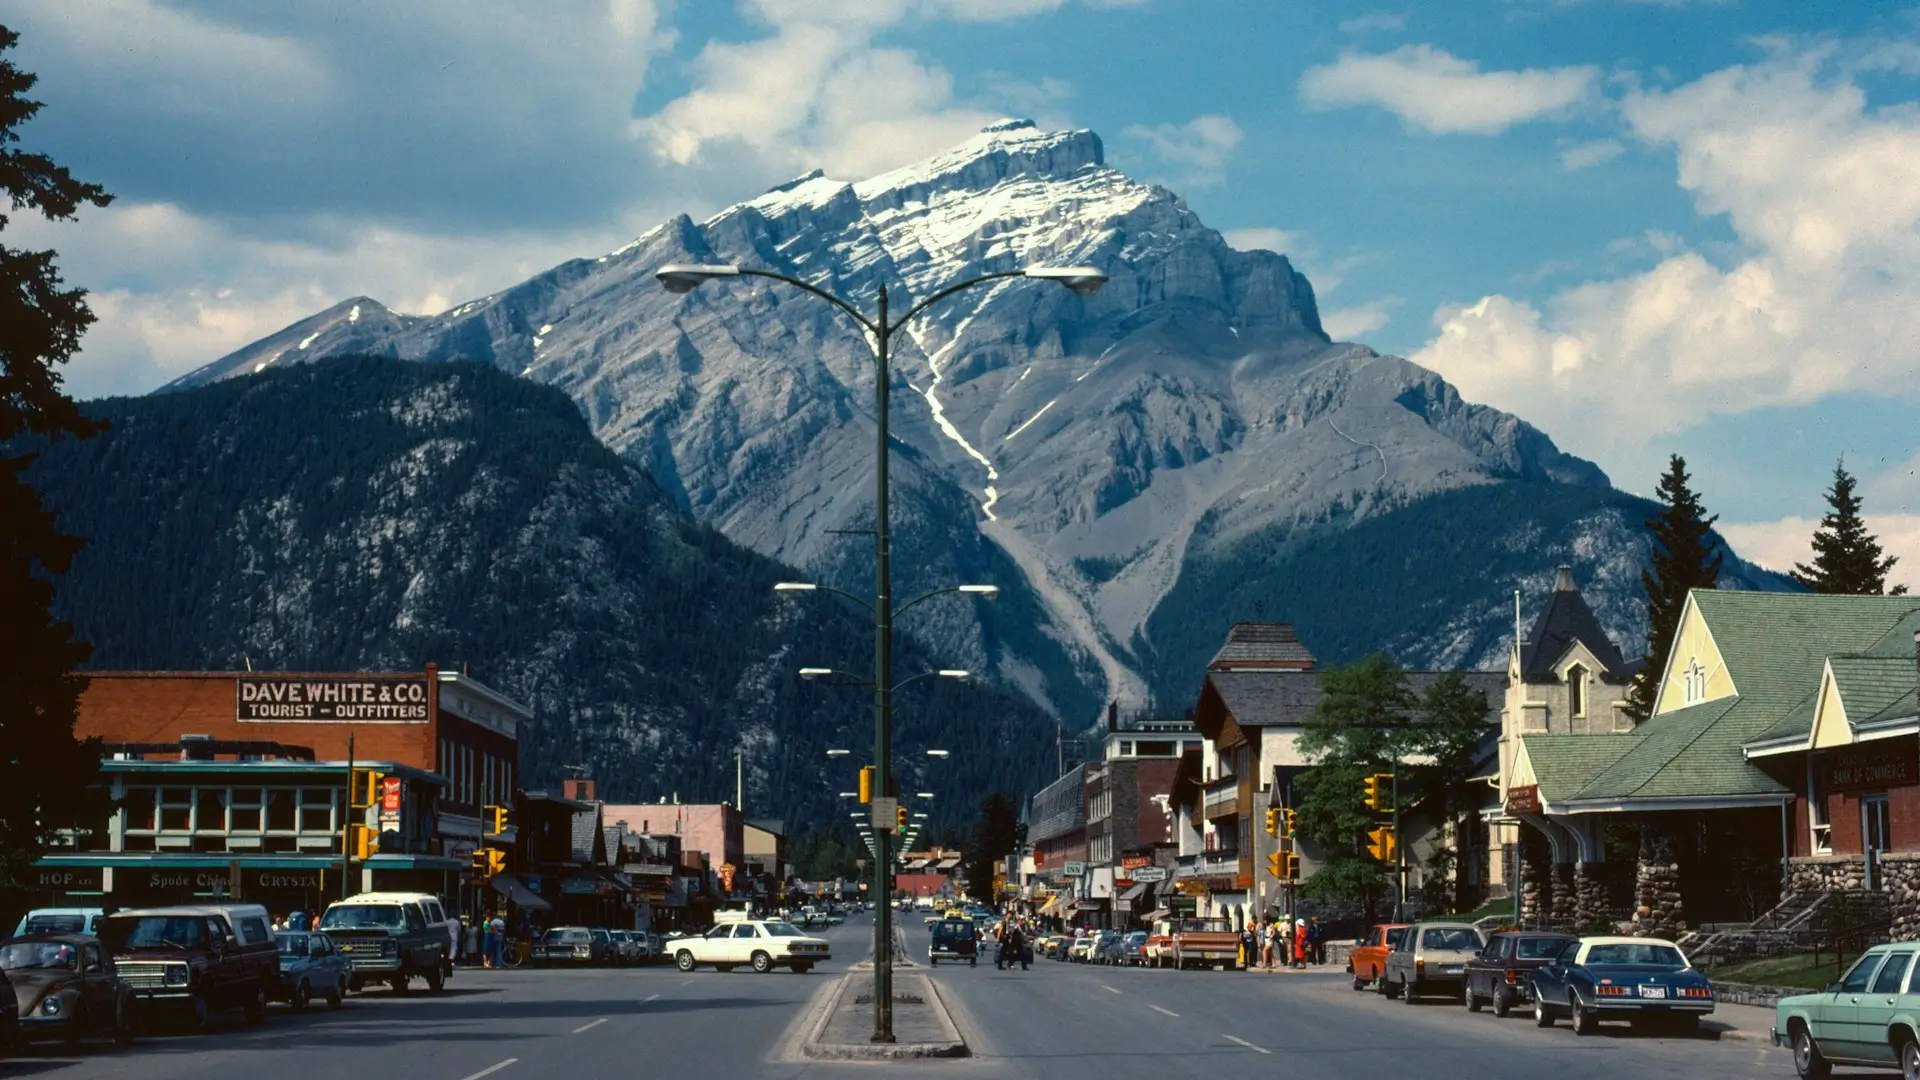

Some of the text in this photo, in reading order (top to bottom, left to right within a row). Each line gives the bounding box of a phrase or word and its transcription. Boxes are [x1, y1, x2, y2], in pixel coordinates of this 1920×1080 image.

[242, 683, 427, 703] DAVE WHITE & CO.
[249, 704, 314, 717] TOURIST
[336, 705, 427, 718] OUTFITTERS
[1833, 762, 1907, 785] BANK OF COMMERCE
[149, 872, 191, 888] Spode
[259, 873, 327, 887] CRYSTA
